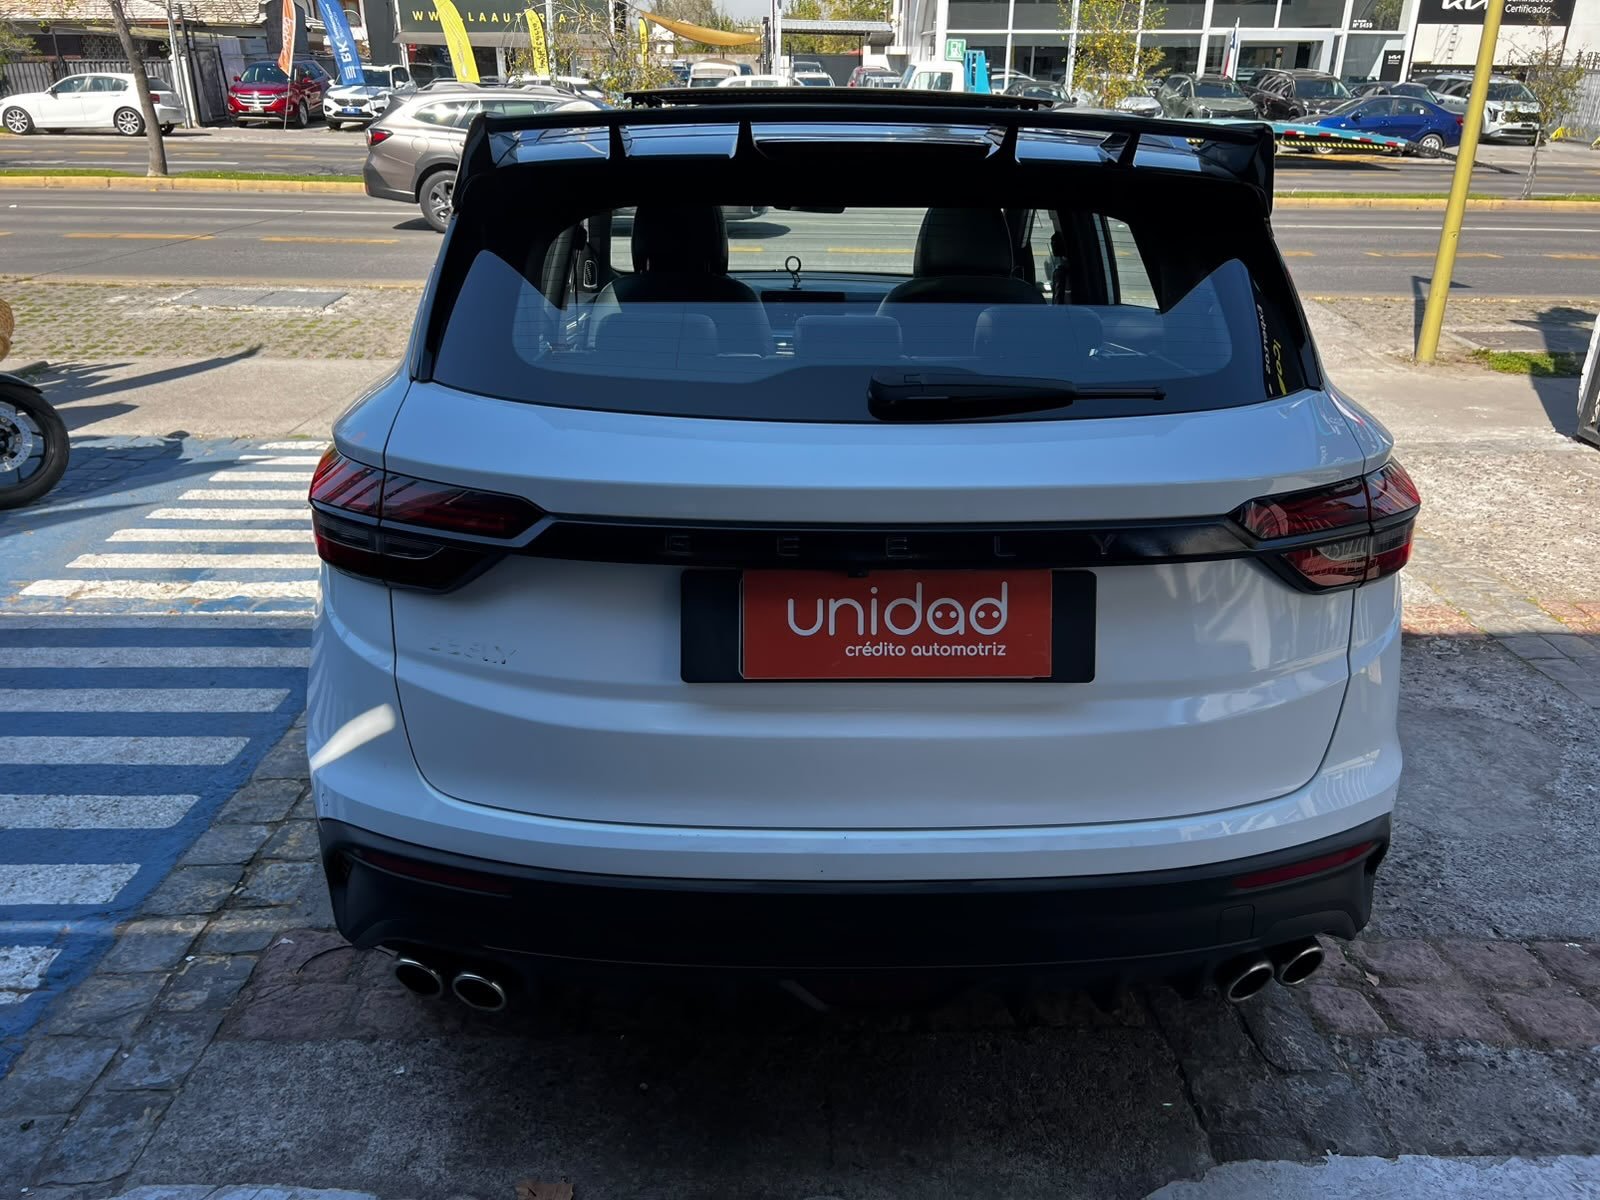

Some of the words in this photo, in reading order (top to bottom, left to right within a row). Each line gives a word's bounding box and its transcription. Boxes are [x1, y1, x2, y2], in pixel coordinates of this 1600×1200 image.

[339, 40, 353, 63] BK
[787, 581, 1008, 637] unidad
[845, 641, 906, 658] crédito
[911, 641, 1006, 658] automotriz
